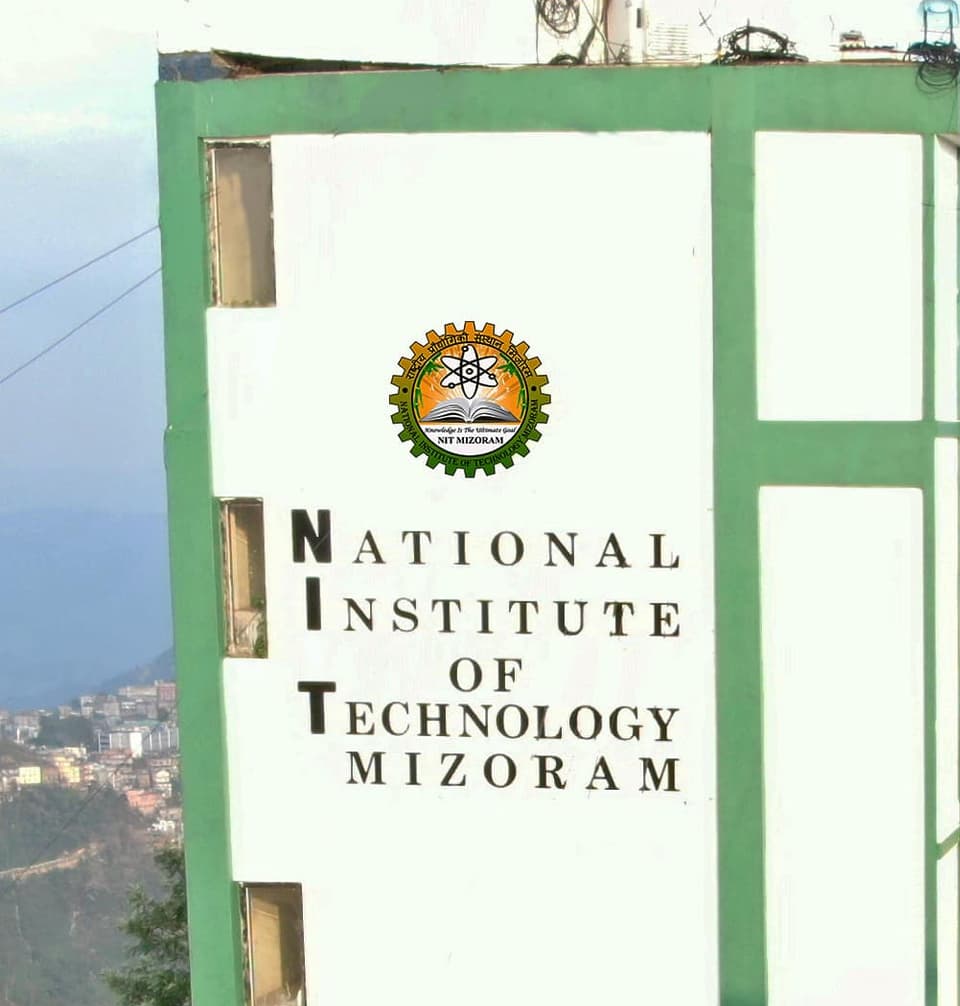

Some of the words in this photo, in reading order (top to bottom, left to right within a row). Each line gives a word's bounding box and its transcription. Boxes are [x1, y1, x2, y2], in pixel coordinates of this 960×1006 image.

[400, 401, 420, 442] NATIONAL
[418, 440, 459, 467] INSTITUTE
[460, 459, 472, 467] OF
[474, 437, 525, 467] TECHNOLOGY
[521, 400, 538, 438] MIZORAM
[291, 509, 681, 570] NATIONAL
[306, 577, 681, 637] INSTITUTE
[449, 657, 523, 692] OF
[297, 681, 681, 742] TECHNOLOGY
[346, 751, 681, 792] MIZORAM
